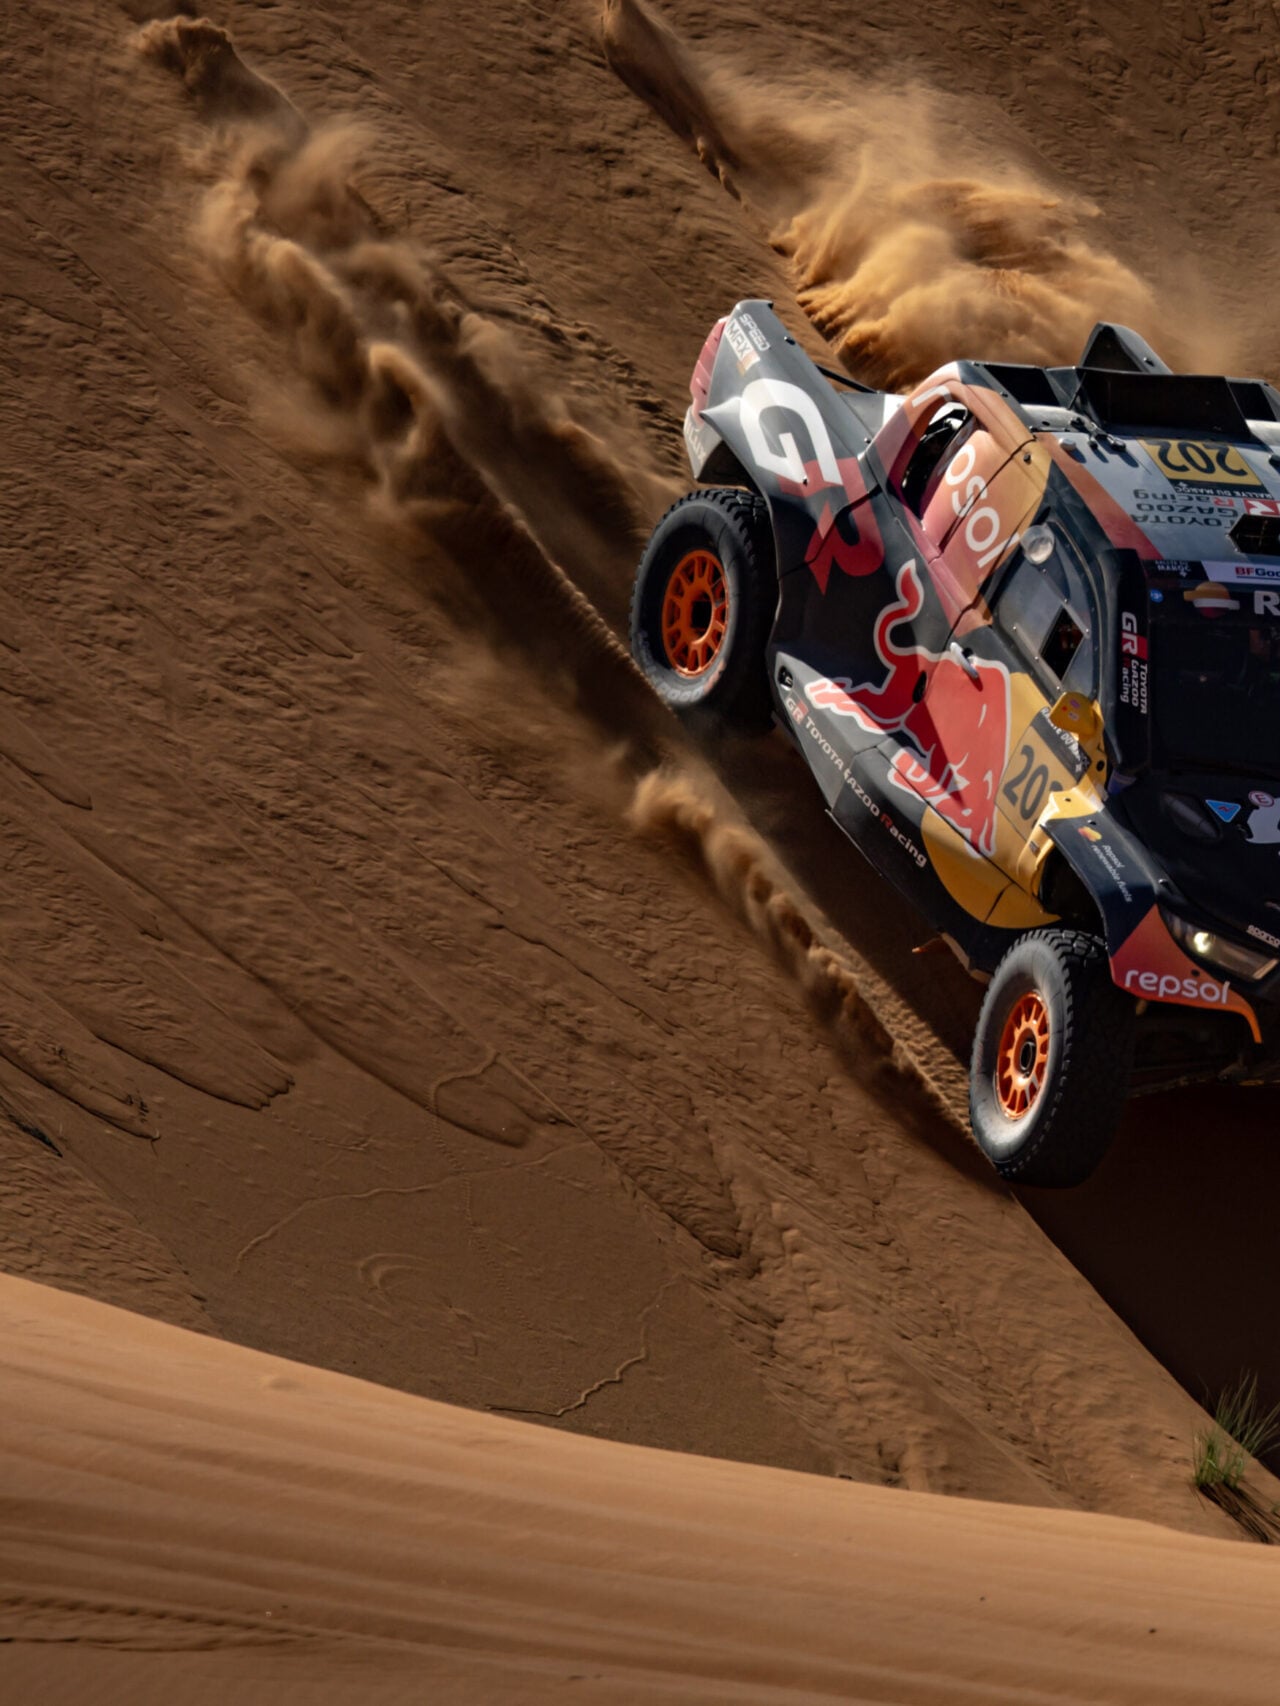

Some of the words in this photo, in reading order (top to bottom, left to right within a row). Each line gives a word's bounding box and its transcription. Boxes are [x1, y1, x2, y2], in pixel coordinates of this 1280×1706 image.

[727, 320, 753, 361] MAX
[738, 312, 771, 352] SPEED
[1145, 440, 1248, 477] 202
[1133, 489, 1235, 507] Racing
[1136, 502, 1239, 518] GAZOO
[1121, 610, 1139, 656] GR
[1130, 658, 1140, 708] GAZOO
[1139, 662, 1149, 715] TOYOTA
[785, 696, 809, 725] GR
[804, 715, 845, 771] TOYOTA
[843, 766, 881, 818] GAZOO
[879, 811, 928, 868] Racing
[1002, 744, 1064, 822] 20
[1124, 969, 1231, 1004] repsol
